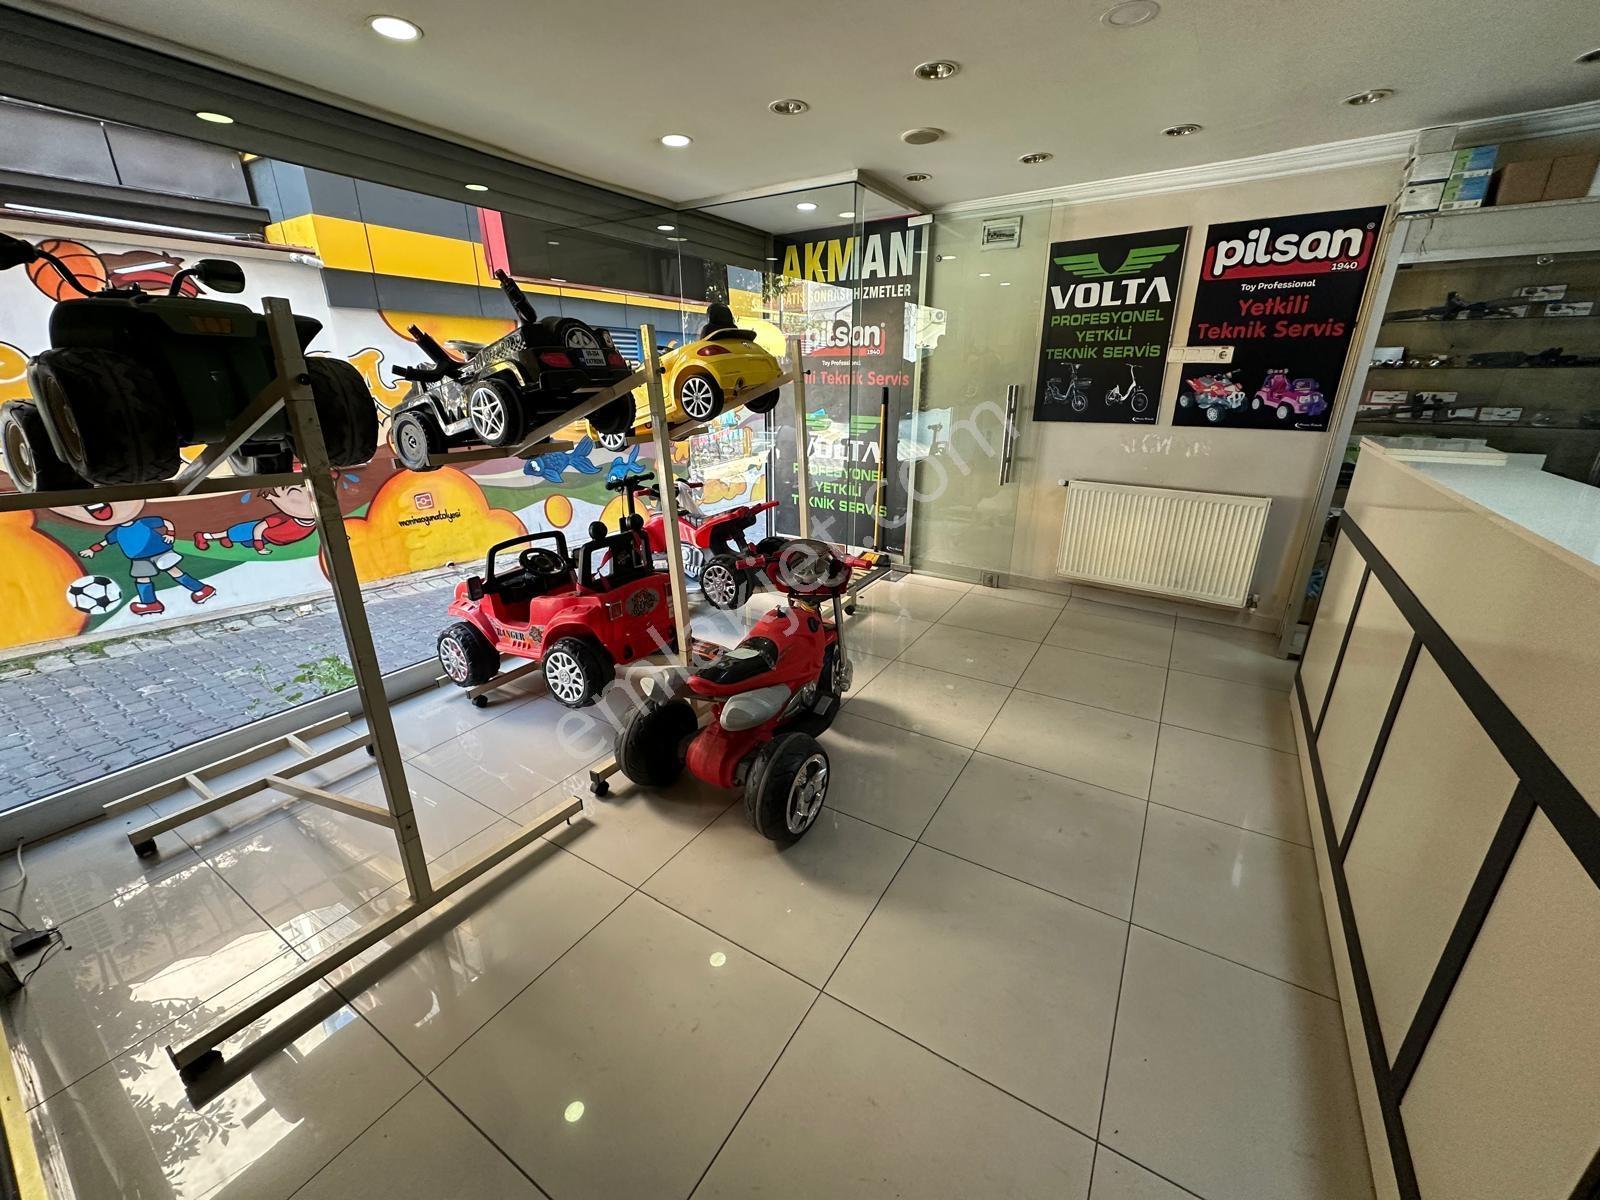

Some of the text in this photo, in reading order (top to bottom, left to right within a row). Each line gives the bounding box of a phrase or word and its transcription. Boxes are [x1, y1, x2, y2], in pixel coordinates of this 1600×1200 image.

[782, 229, 915, 286] AKMAN
[1213, 227, 1364, 276] pilsan
[1331, 261, 1358, 271] 1940
[1050, 276, 1172, 310] VOLTA
[1241, 279, 1316, 292] Toy Professional
[1238, 295, 1311, 318] Yetkili
[1050, 309, 1165, 328] PROFESYONEL
[1075, 325, 1133, 343] YETKİLİ
[1197, 318, 1346, 340] Teknik Servis
[1046, 342, 1161, 360] TEKNİK SERVİS
[821, 370, 863, 386] Teknik
[866, 370, 910, 387] Servis
[496, 627, 526, 641] RANGER
